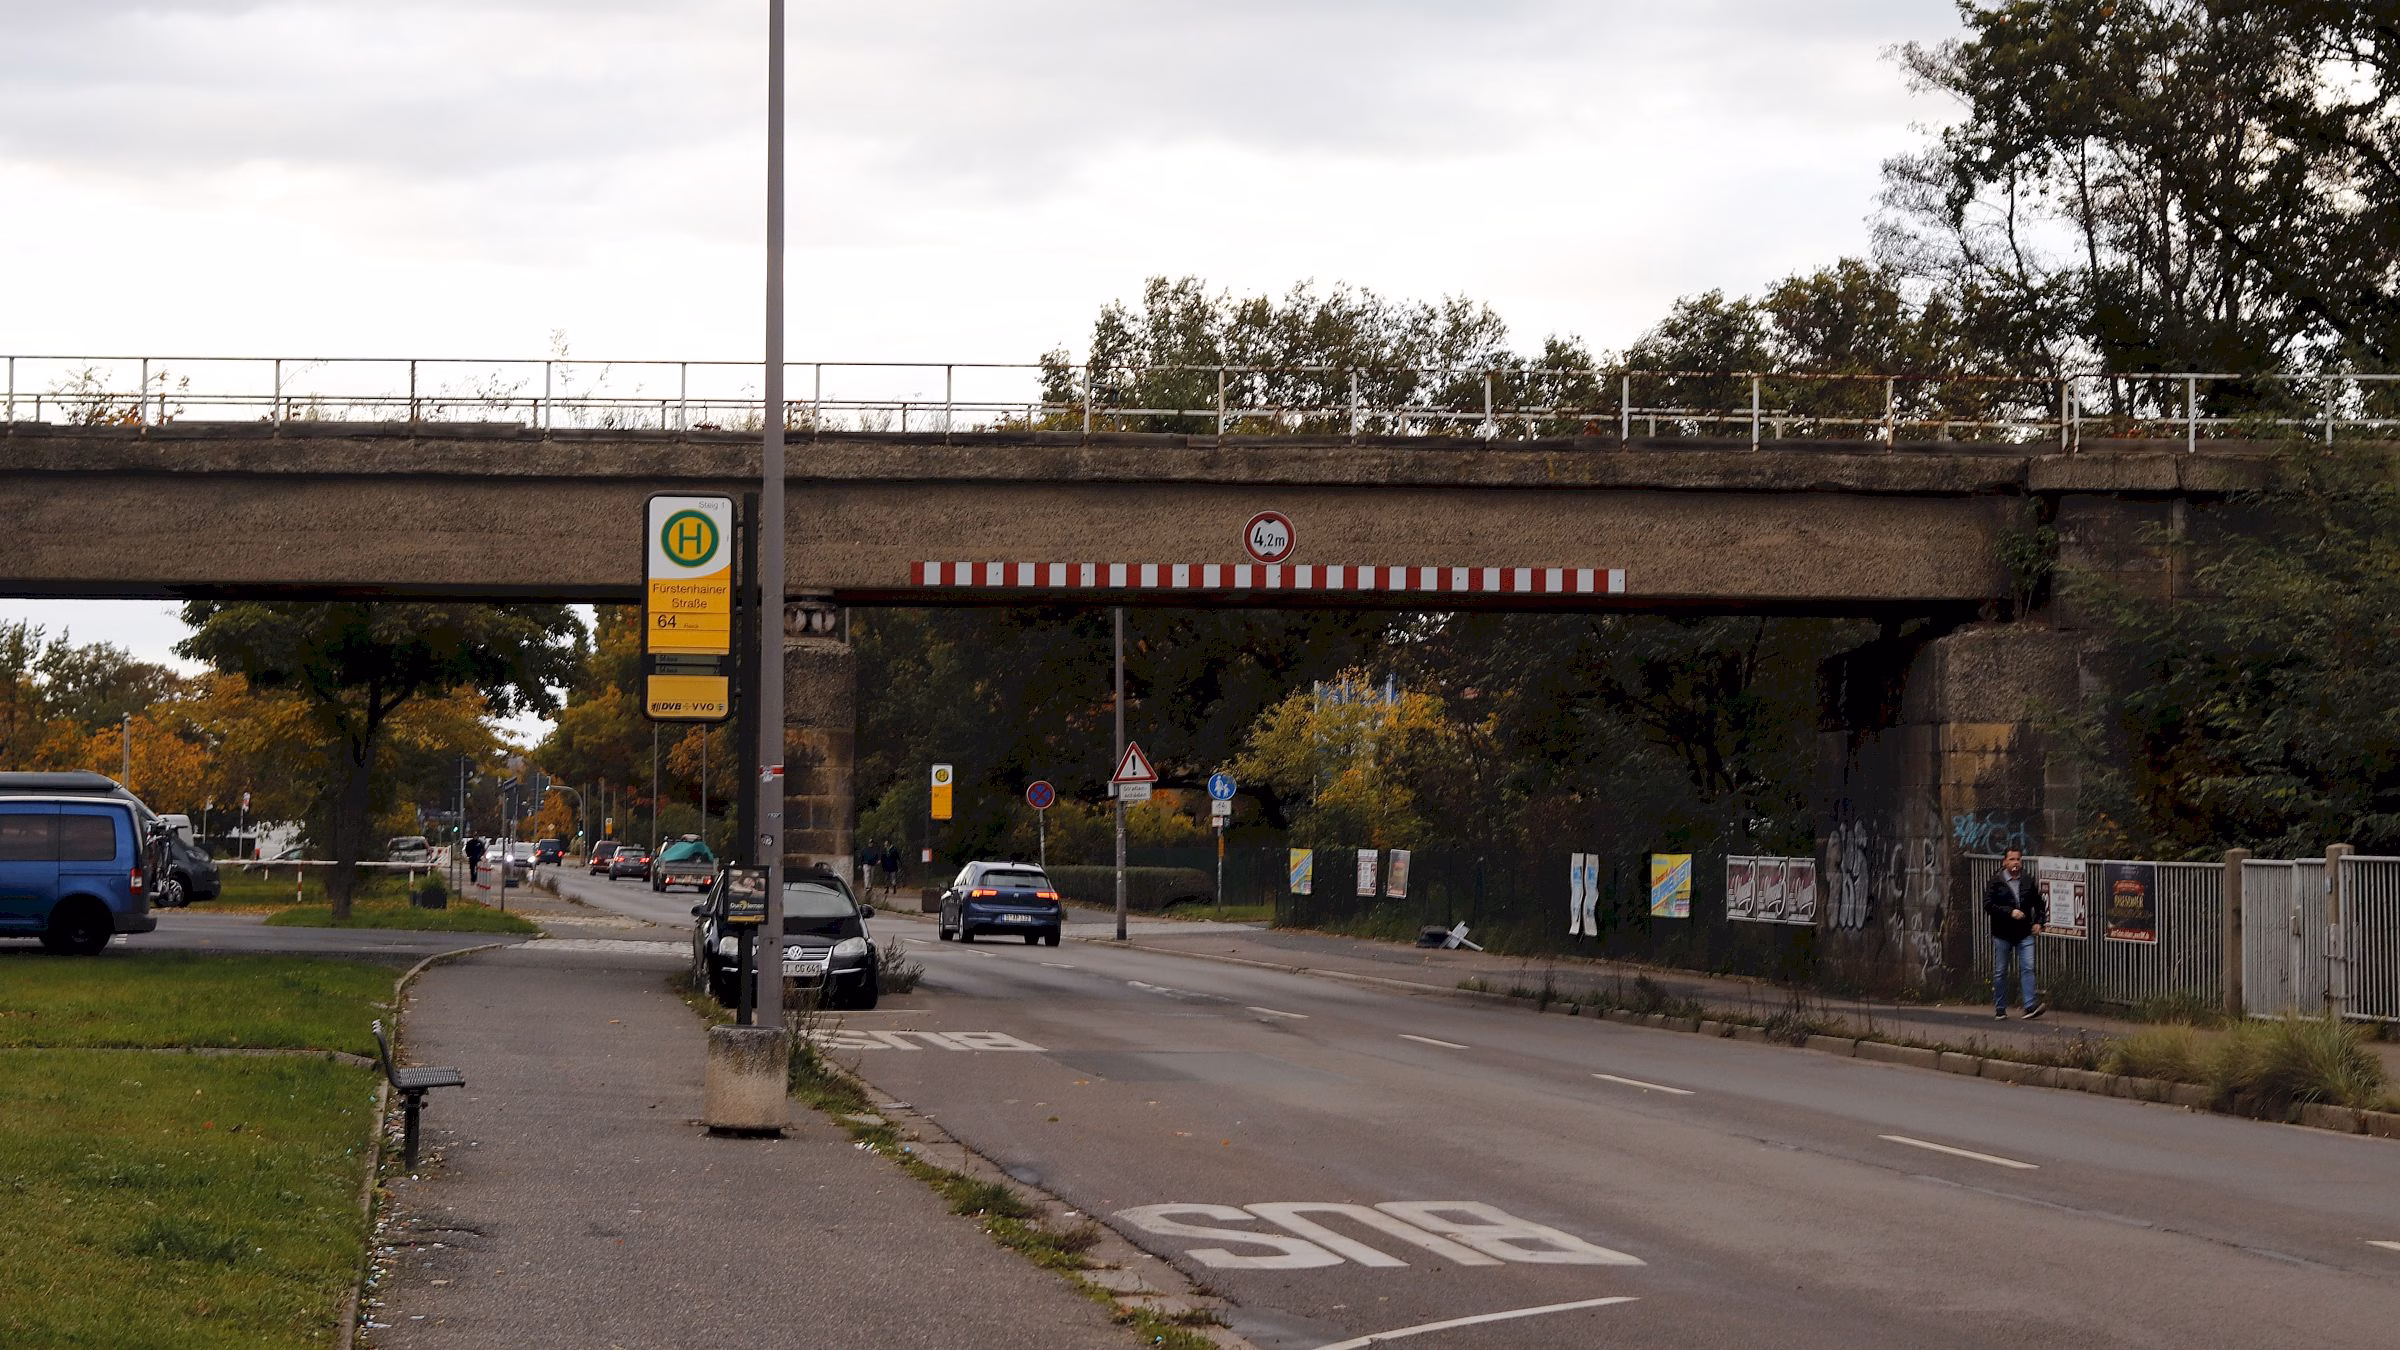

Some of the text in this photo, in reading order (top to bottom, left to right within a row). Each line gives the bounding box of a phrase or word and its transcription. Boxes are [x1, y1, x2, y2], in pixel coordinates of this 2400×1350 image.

[698, 500, 719, 511] Steig
[677, 521, 703, 555] H
[652, 582, 728, 595] Fürstenhainer
[671, 597, 708, 609] Straße
[657, 614, 677, 628] 64
[660, 702, 715, 712] DVB VVO
[1111, 1200, 1647, 1269] BUS
